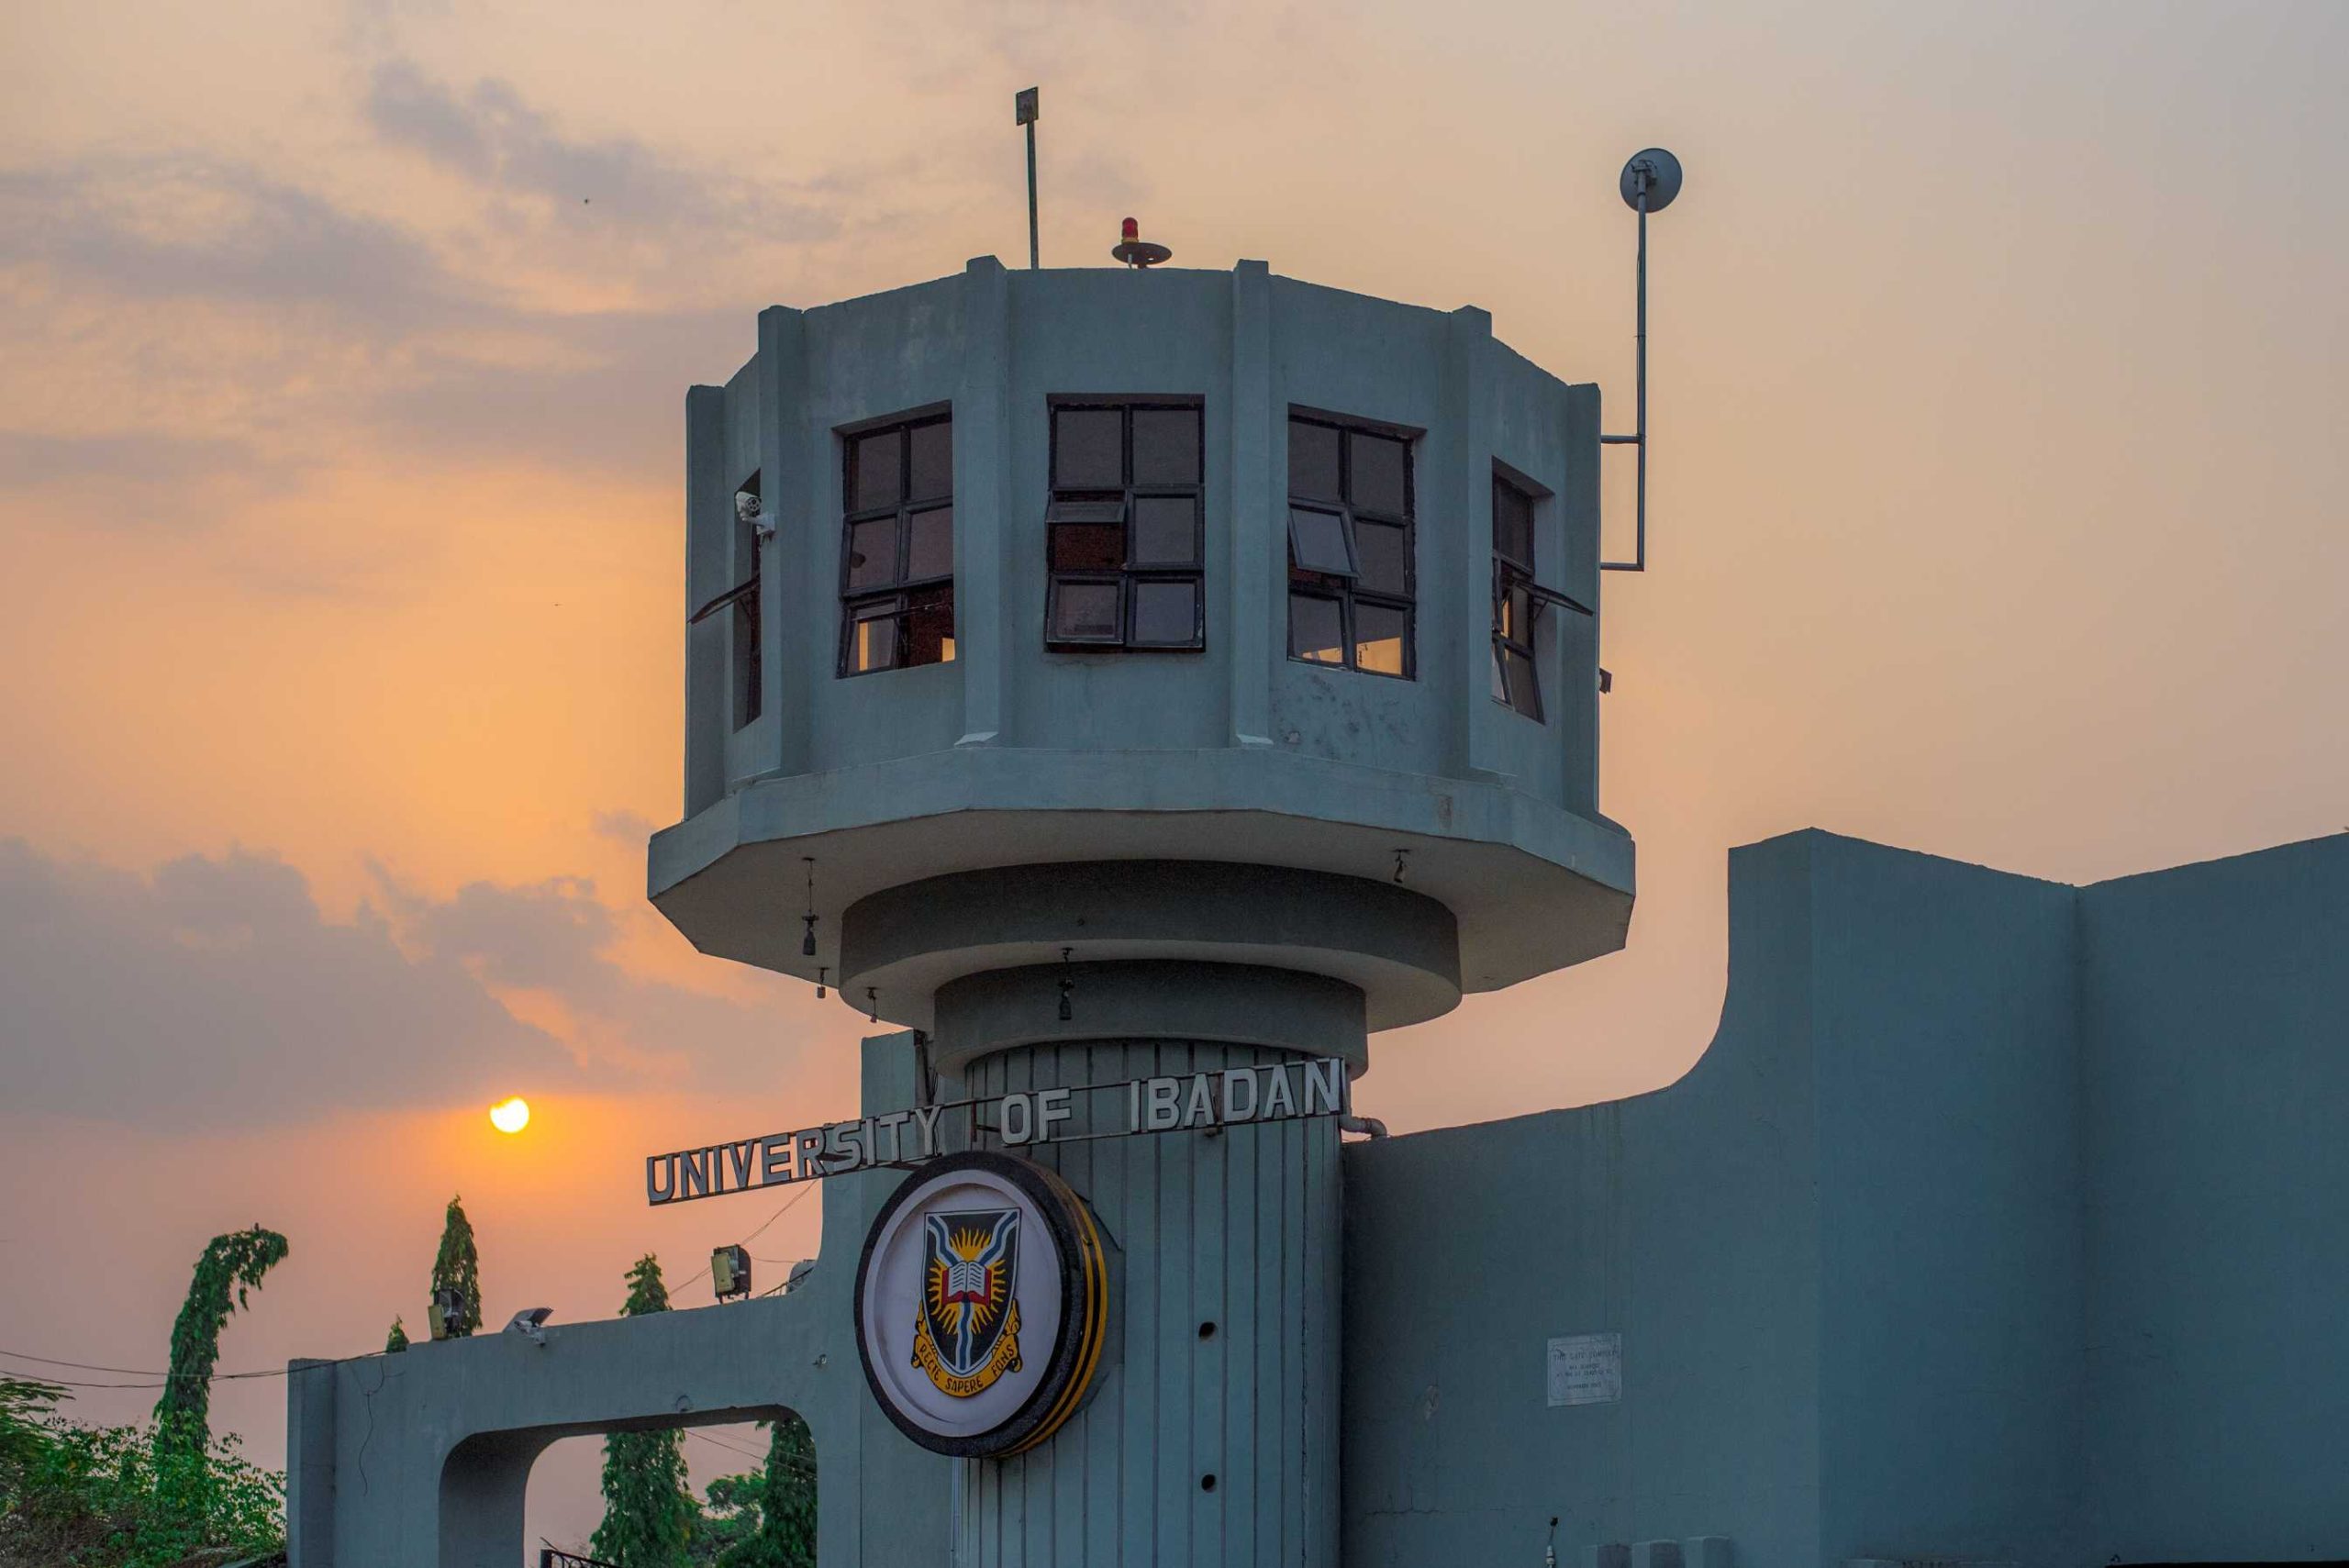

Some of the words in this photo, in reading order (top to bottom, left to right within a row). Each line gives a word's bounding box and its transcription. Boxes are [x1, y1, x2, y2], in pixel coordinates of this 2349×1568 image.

[647, 1106, 942, 1202] UNIVERSITY
[1001, 1088, 1072, 1144] OF
[1130, 1058, 1343, 1130] IBADAN
[919, 1344, 941, 1381] RECTE
[946, 1377, 984, 1393] SAPERE
[992, 1345, 1015, 1376] FONS
